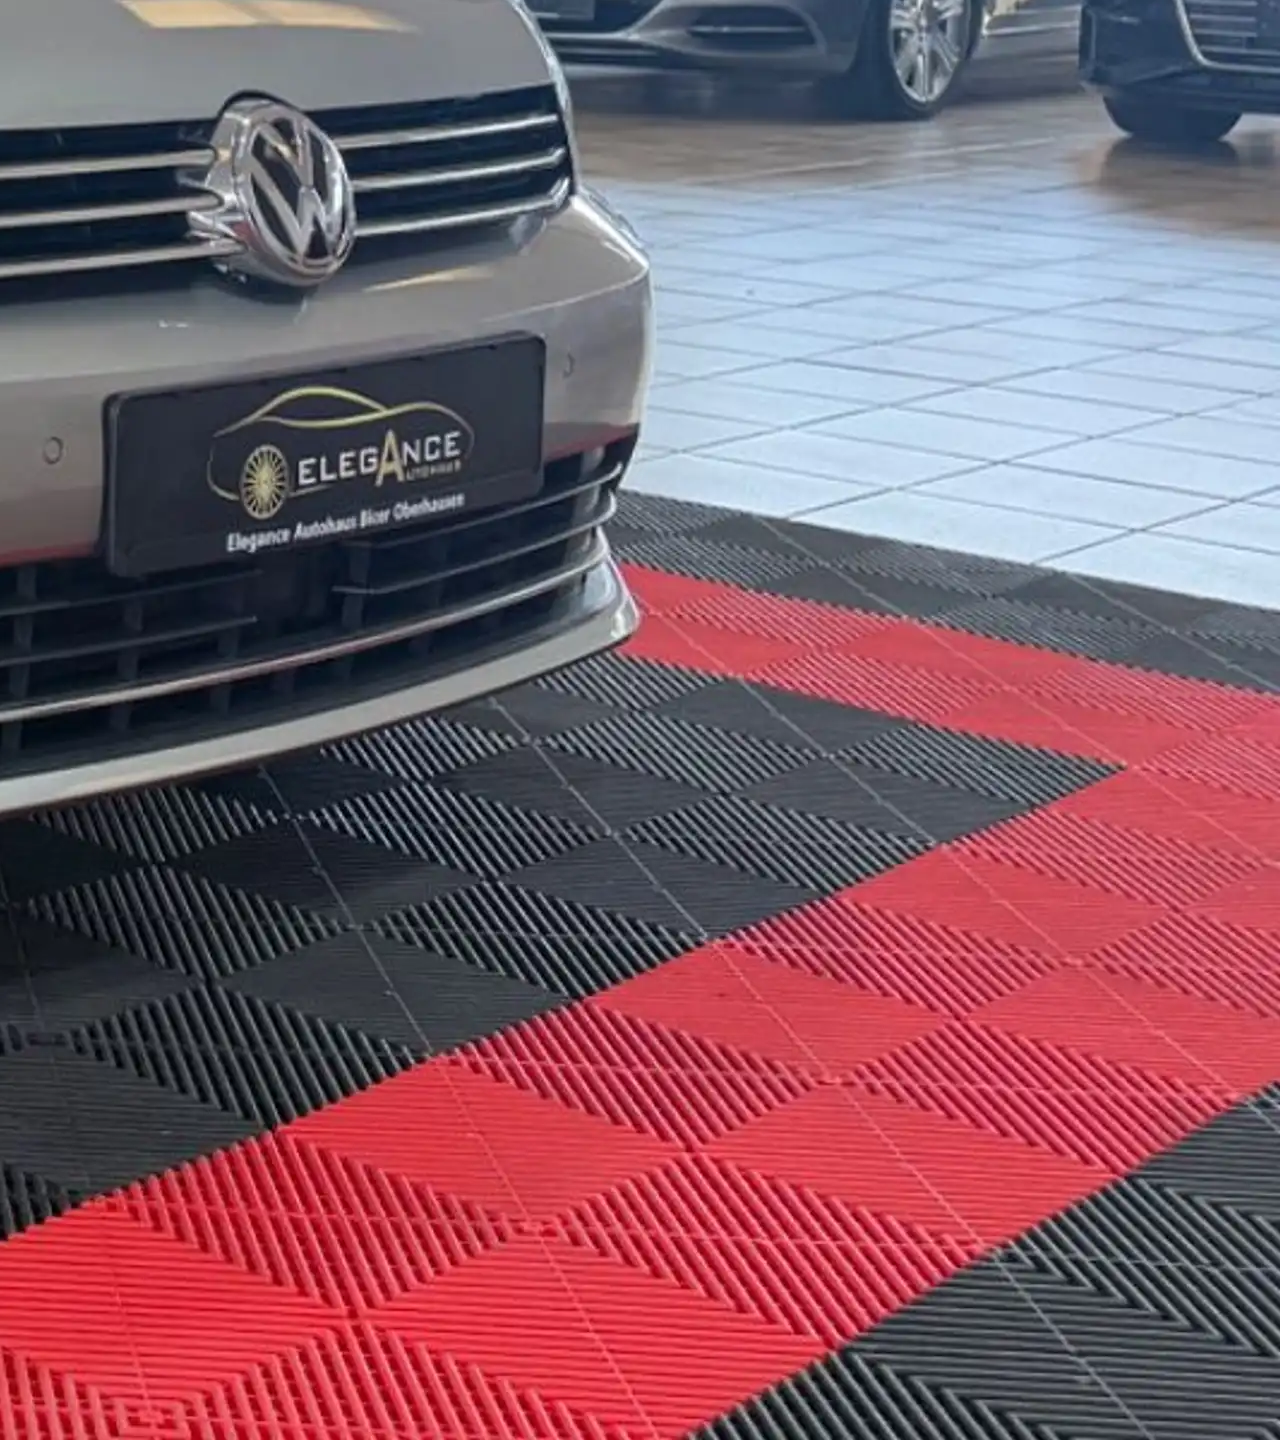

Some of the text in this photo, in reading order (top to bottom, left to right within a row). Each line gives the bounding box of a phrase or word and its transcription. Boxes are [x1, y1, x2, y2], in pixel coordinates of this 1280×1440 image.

[297, 428, 462, 487] ELEGANCE
[226, 528, 291, 554] Elegance
[294, 514, 358, 541] Autohaus
[393, 492, 466, 522] Oberhausen
